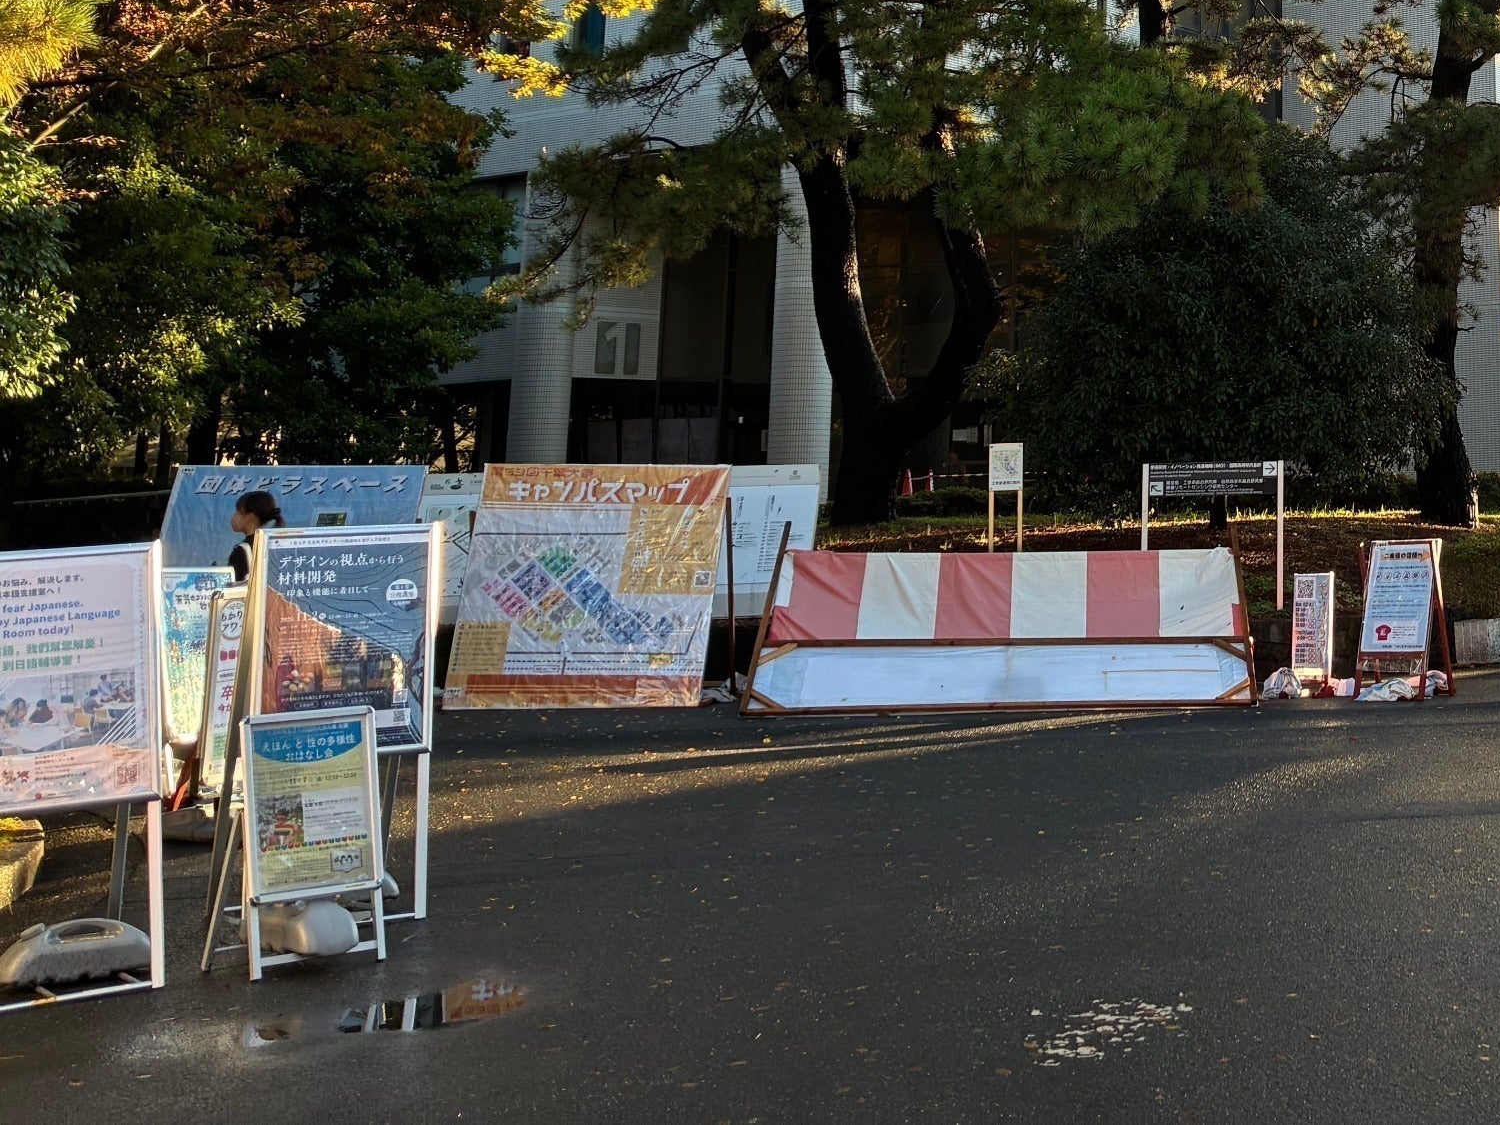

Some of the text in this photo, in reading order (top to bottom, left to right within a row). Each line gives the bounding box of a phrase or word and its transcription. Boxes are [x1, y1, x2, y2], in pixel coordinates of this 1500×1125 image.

[195, 475, 408, 495] 団体ビラスペース
[508, 479, 691, 504] キャンパスマップ
[278, 553, 404, 569] デザインの視点から行う
[276, 570, 337, 586] 材料開発
[0, 587, 61, 599] 本語支援室へ！
[2, 600, 84, 614] fear Japanese.
[13, 613, 65, 626] Japanese
[68, 609, 121, 622] Language
[3, 624, 74, 639] Room today!
[285, 748, 334, 761] おはなし会
